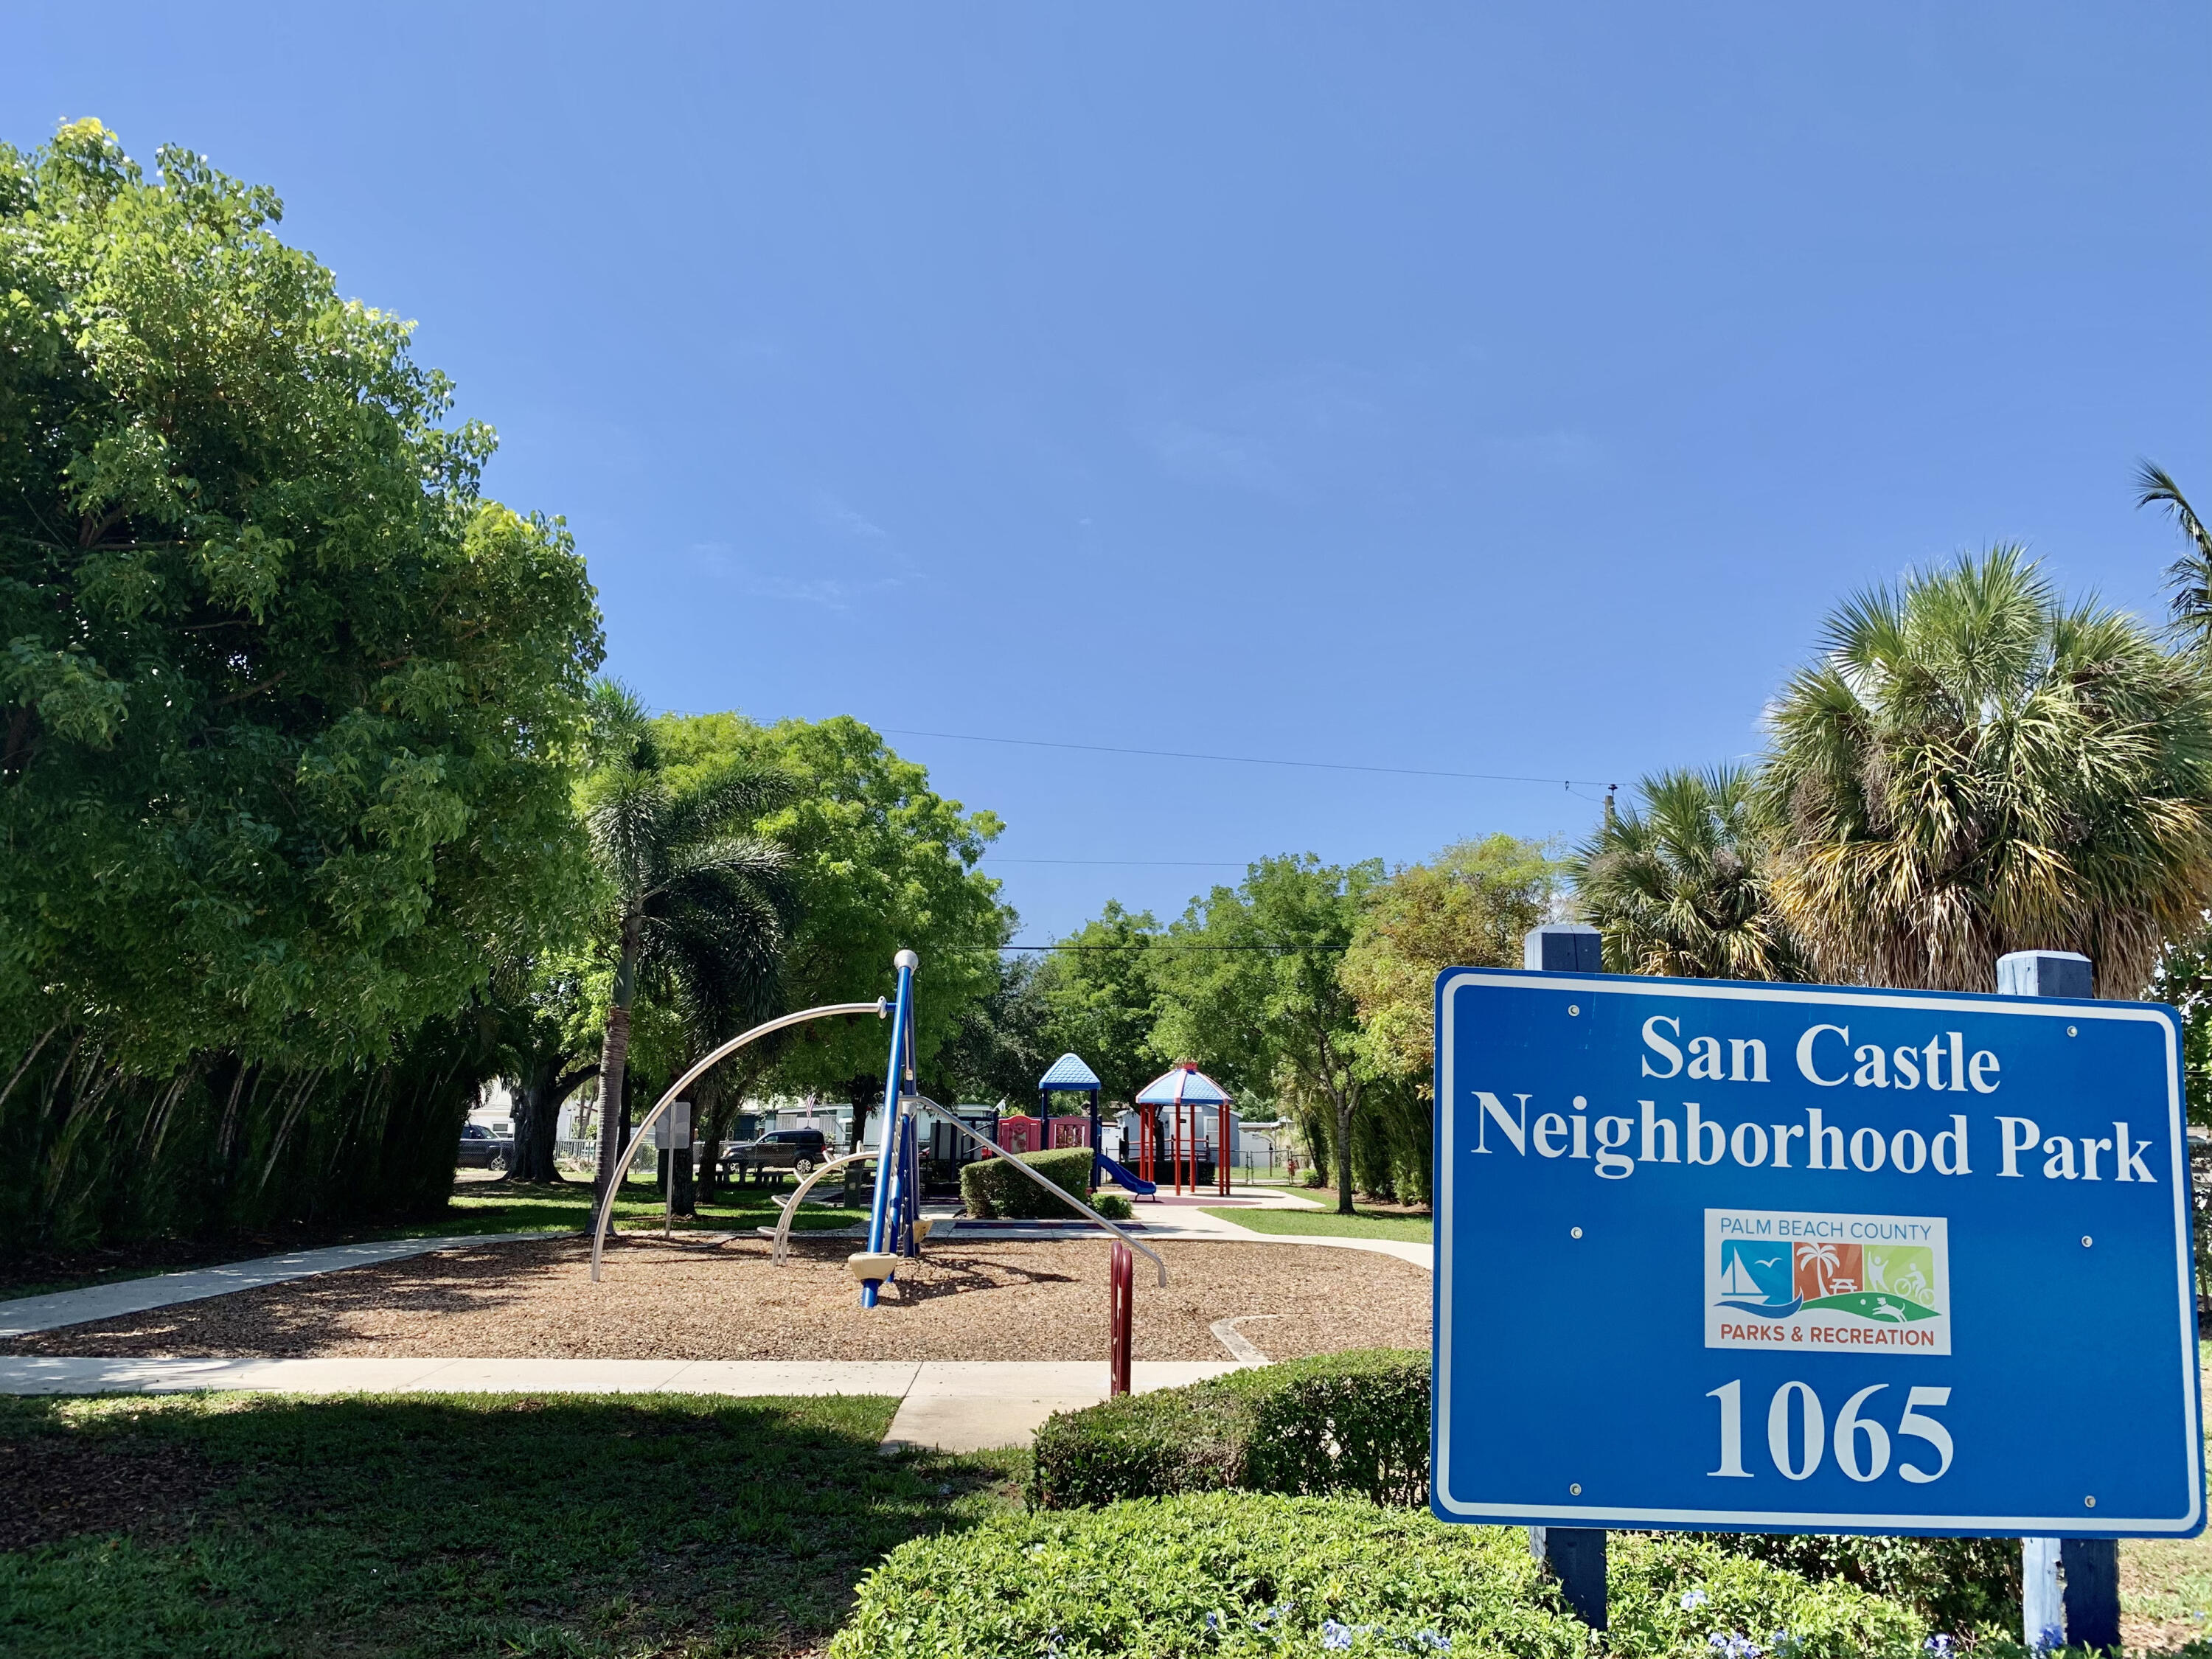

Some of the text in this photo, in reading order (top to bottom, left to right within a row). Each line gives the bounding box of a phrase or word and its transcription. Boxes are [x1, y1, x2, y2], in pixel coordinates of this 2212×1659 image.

[1641, 1015, 2000, 1093] San Castle
[1471, 1091, 2157, 1183] Neighborhood Park
[1720, 1217, 1932, 1241] PALM BEACH COUNTY
[1720, 1324, 1934, 1346] PARKS & RECREATION
[1705, 1379, 1954, 1484] 1065
